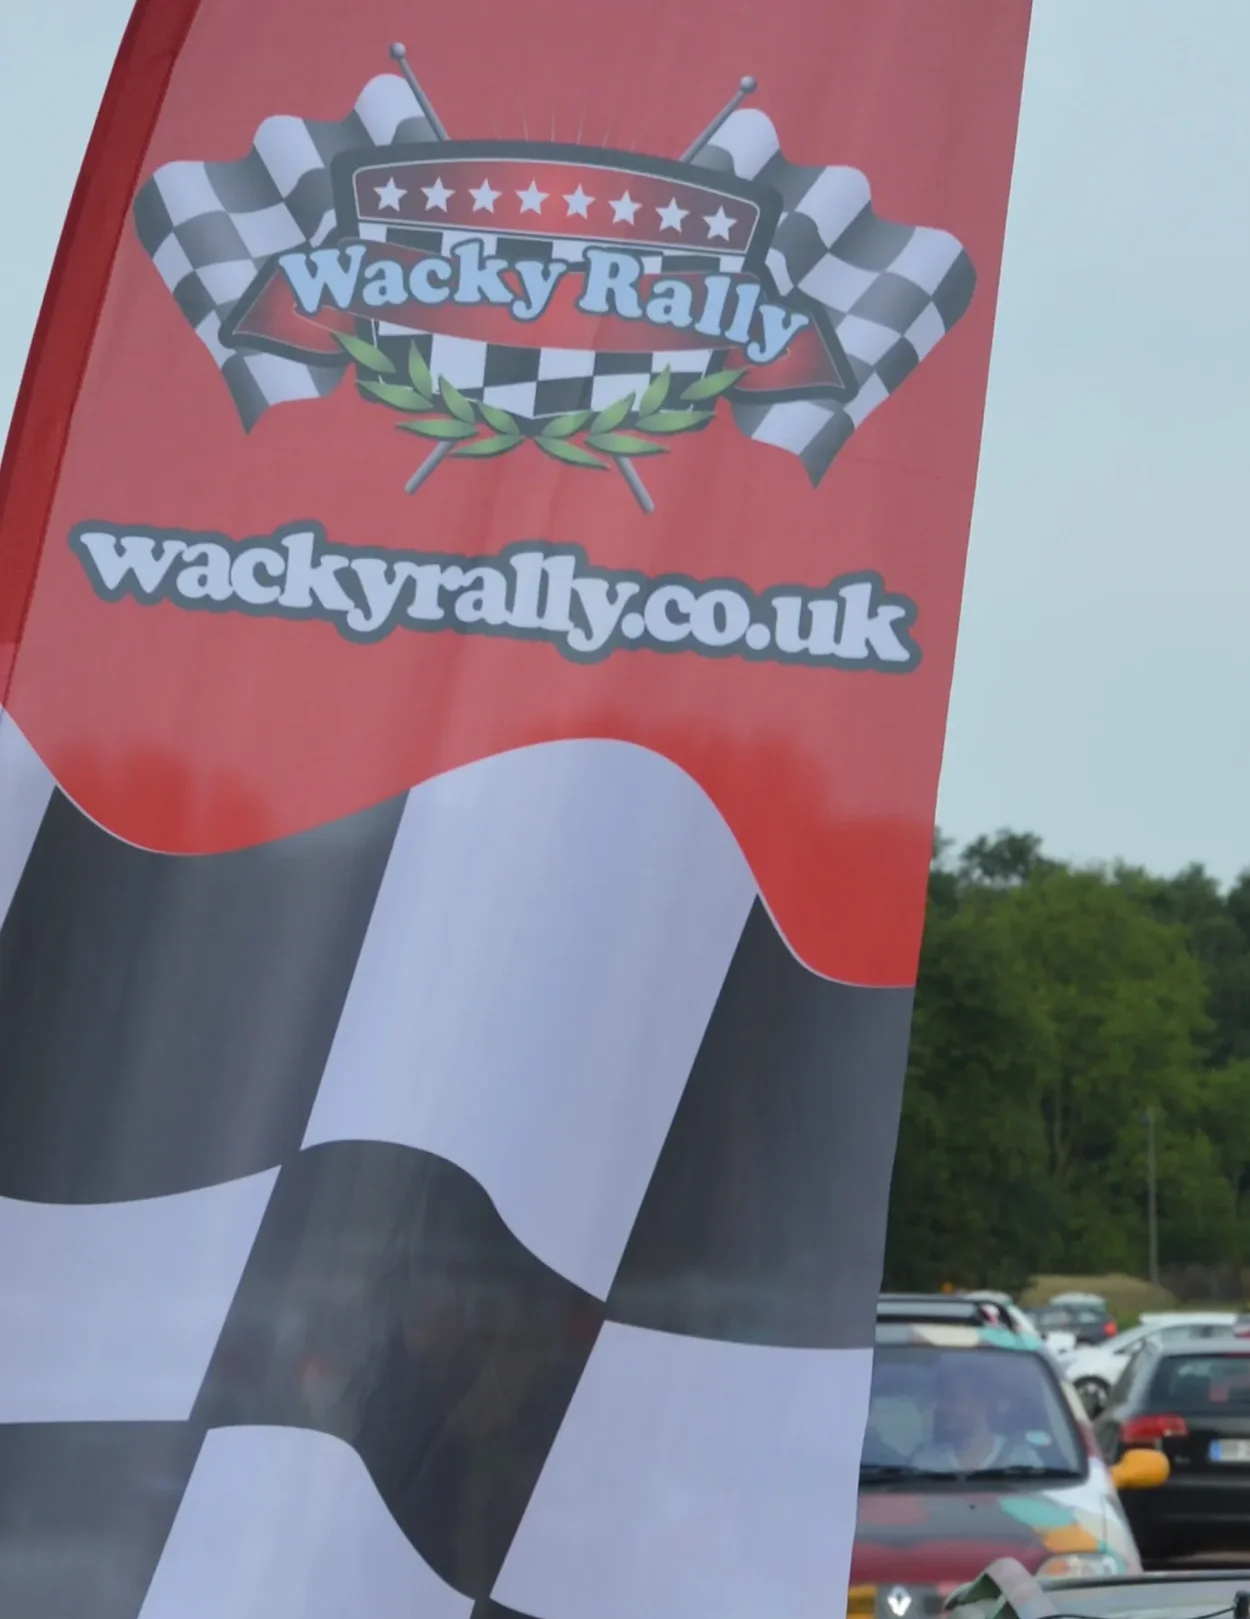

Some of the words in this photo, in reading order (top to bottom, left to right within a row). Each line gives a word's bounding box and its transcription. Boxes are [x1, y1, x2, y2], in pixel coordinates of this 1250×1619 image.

[278, 238, 569, 321] Wacky
[576, 249, 811, 361] Rally
[76, 526, 913, 667] wackyrally.co.uk
